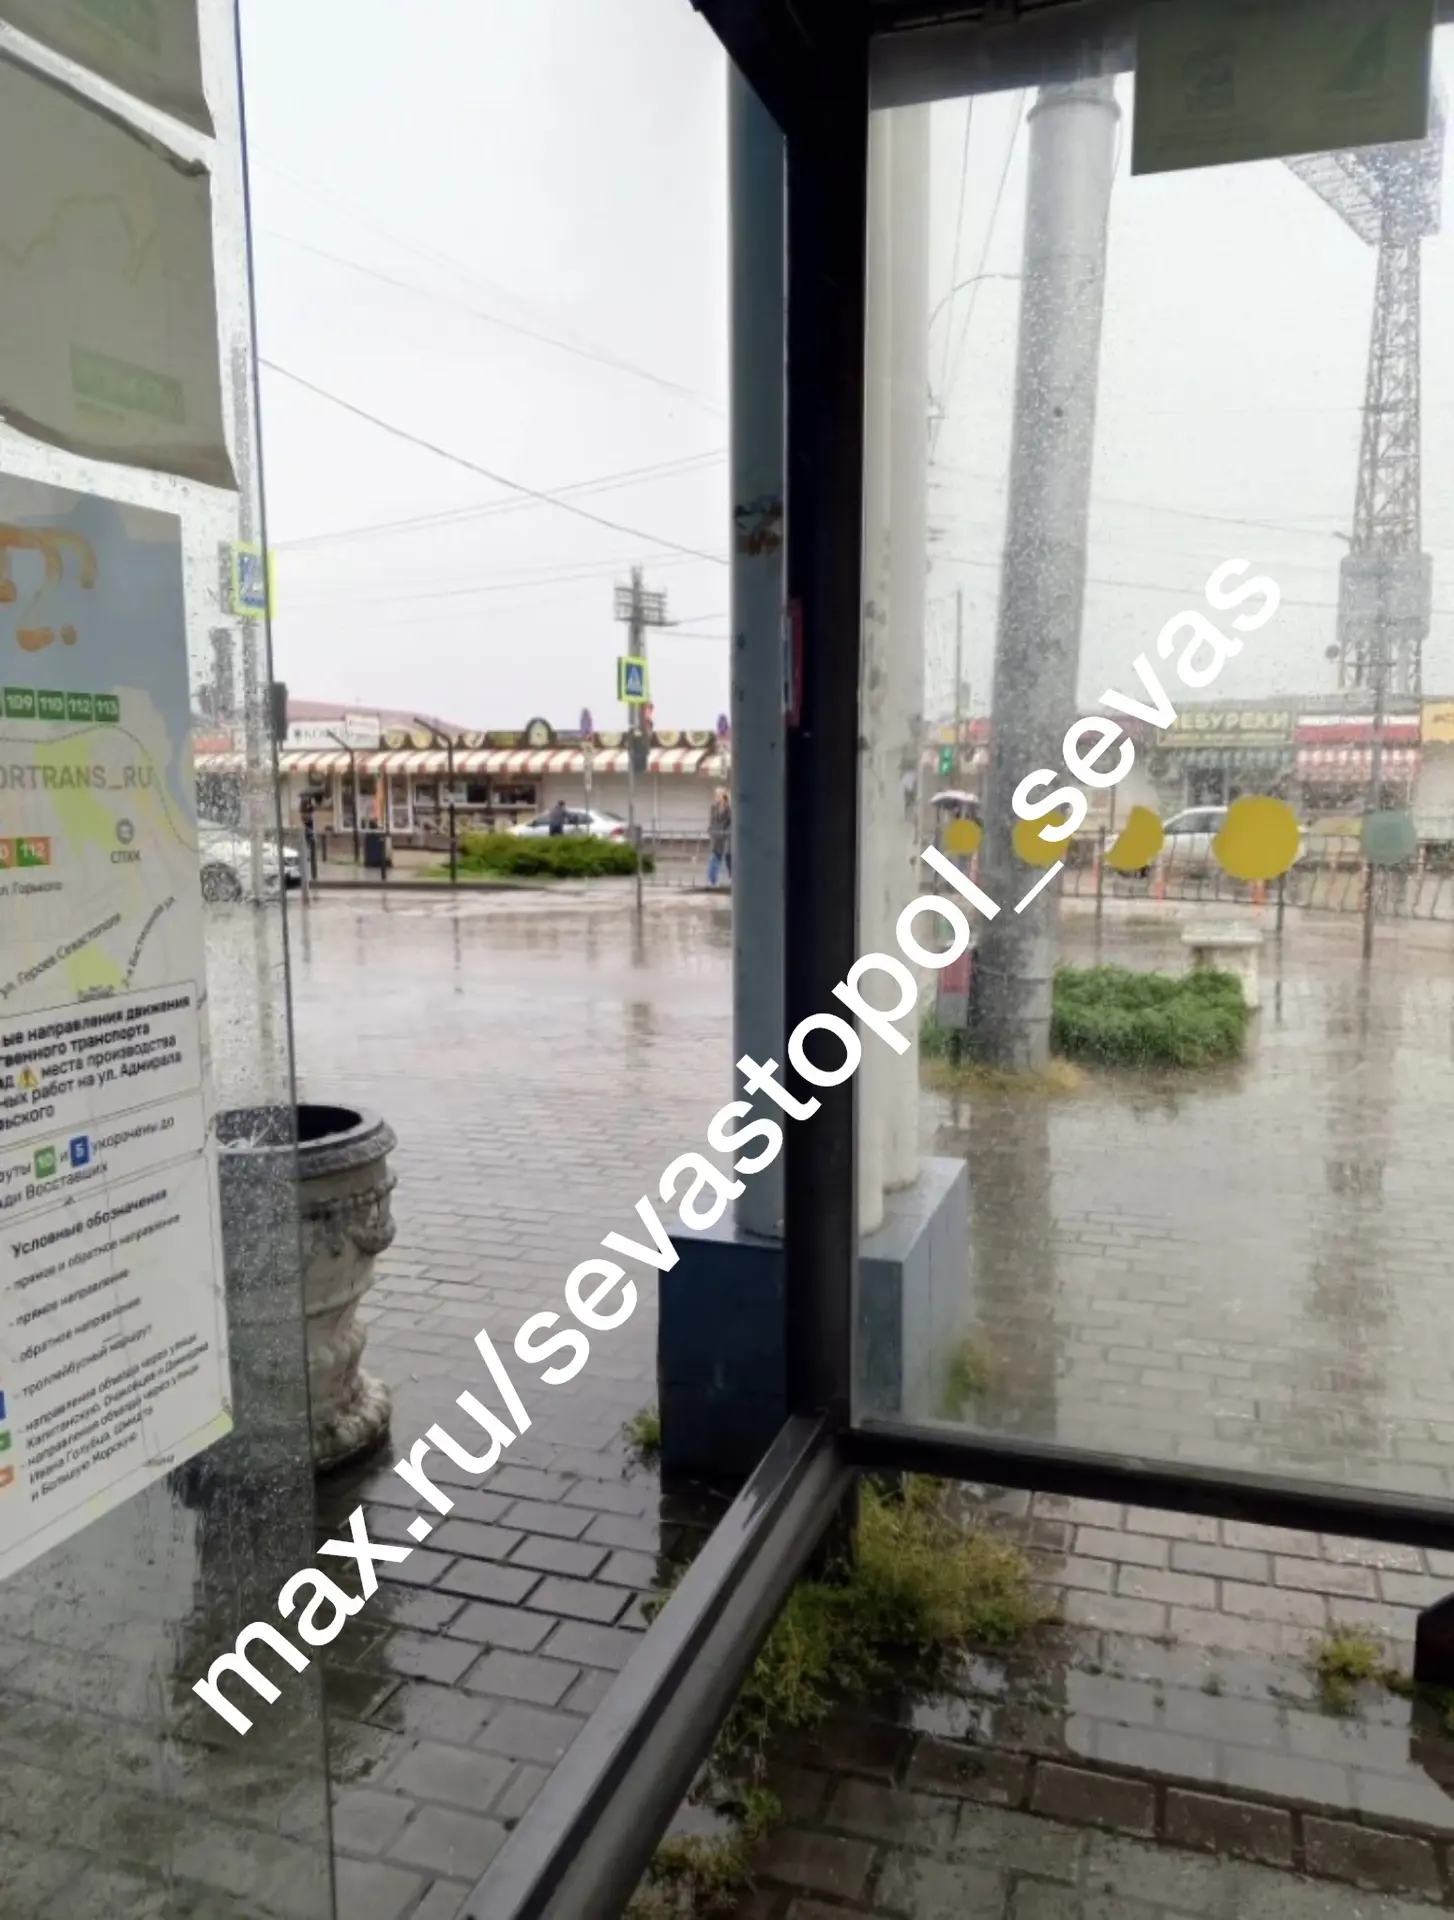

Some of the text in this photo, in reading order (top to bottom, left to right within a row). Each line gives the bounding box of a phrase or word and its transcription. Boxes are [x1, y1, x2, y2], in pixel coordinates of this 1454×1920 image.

[28, 1012, 124, 1042] направления
[126, 996, 190, 1022] движения
[69, 1023, 150, 1053] транспорта
[32, 1078, 74, 1105] работ
[78, 1074, 95, 1088] на
[98, 1069, 117, 1087] ул.
[120, 1051, 183, 1077] Адмирала
[41, 1057, 84, 1080] места
[86, 1035, 177, 1068] производства
[92, 1124, 157, 1156] укорочены
[160, 1116, 175, 1131] до
[25, 1161, 108, 1200] Восставших
[11, 1189, 167, 1258] Условные обозначения
[68, 1240, 118, 1268] обратное
